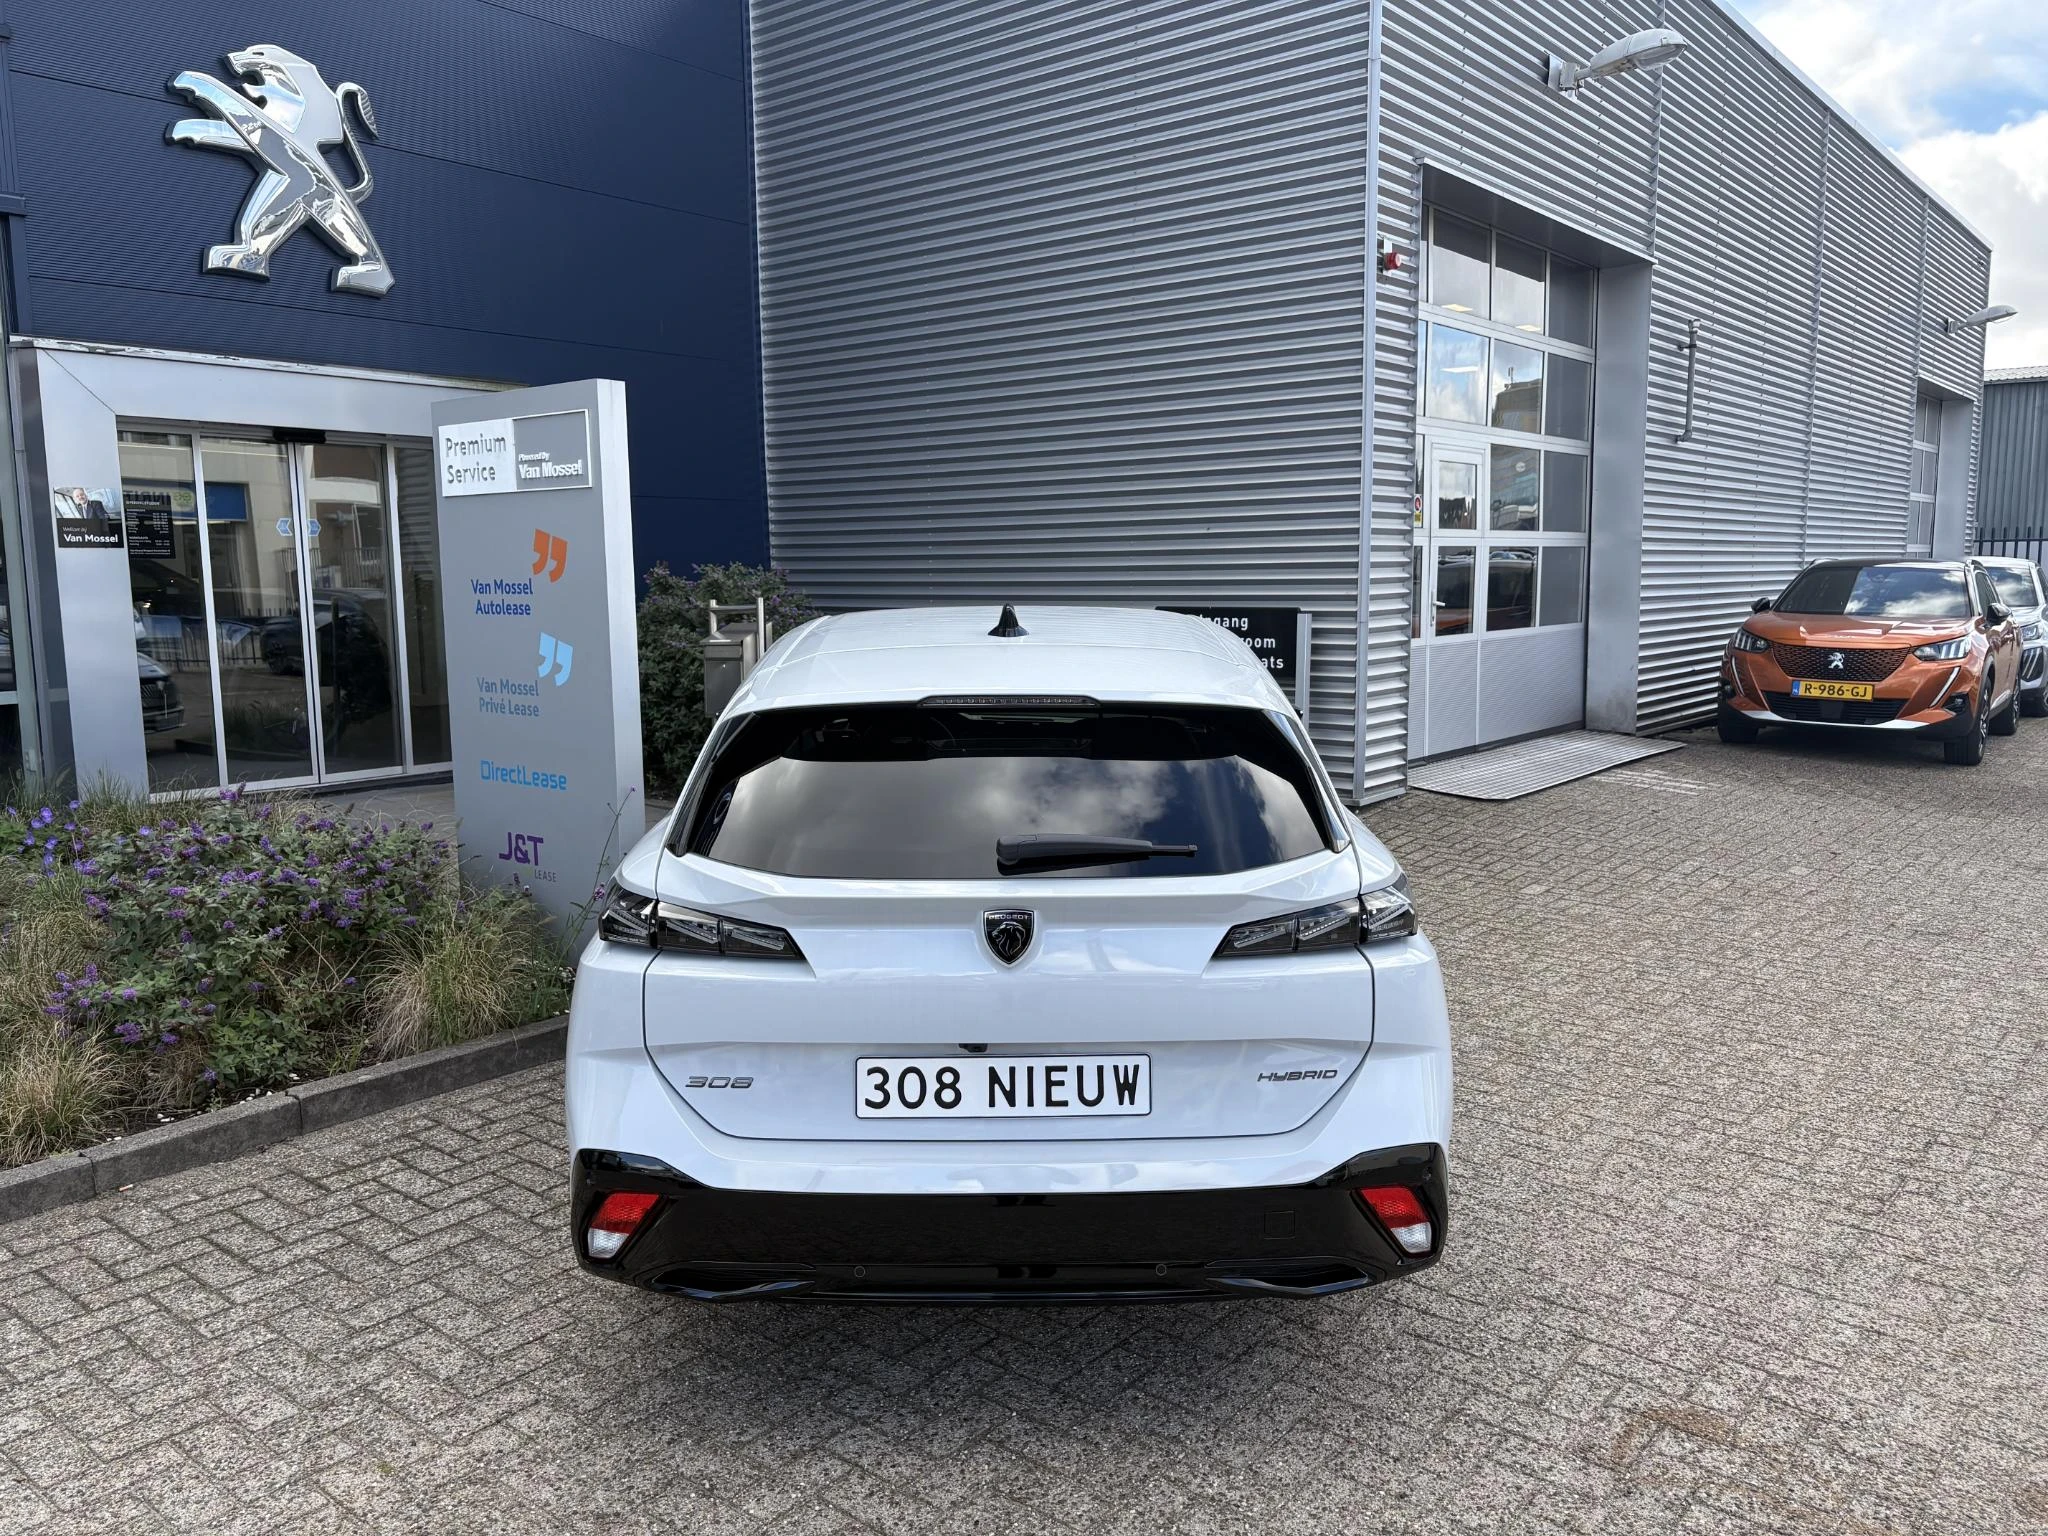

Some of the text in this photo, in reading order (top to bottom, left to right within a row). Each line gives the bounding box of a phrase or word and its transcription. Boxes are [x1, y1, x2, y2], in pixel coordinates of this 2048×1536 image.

[445, 432, 507, 458] Premium
[447, 461, 496, 484] Service
[518, 459, 583, 479] Van Mossel
[64, 533, 82, 543] Van
[84, 533, 118, 543] Mossel
[470, 577, 533, 595] Van Mossel
[475, 599, 532, 616] Autolease
[476, 677, 540, 697] Van Mossel
[1804, 683, 1868, 698] R-986-GJ
[479, 697, 540, 717] Privé Lease
[480, 760, 567, 790] DirectLease
[498, 832, 544, 866] J&T
[534, 869, 557, 882] LEASE
[685, 1076, 754, 1089] 308
[1257, 1069, 1338, 1082] HYBRID
[864, 1064, 1140, 1109] 308 NIEUW
